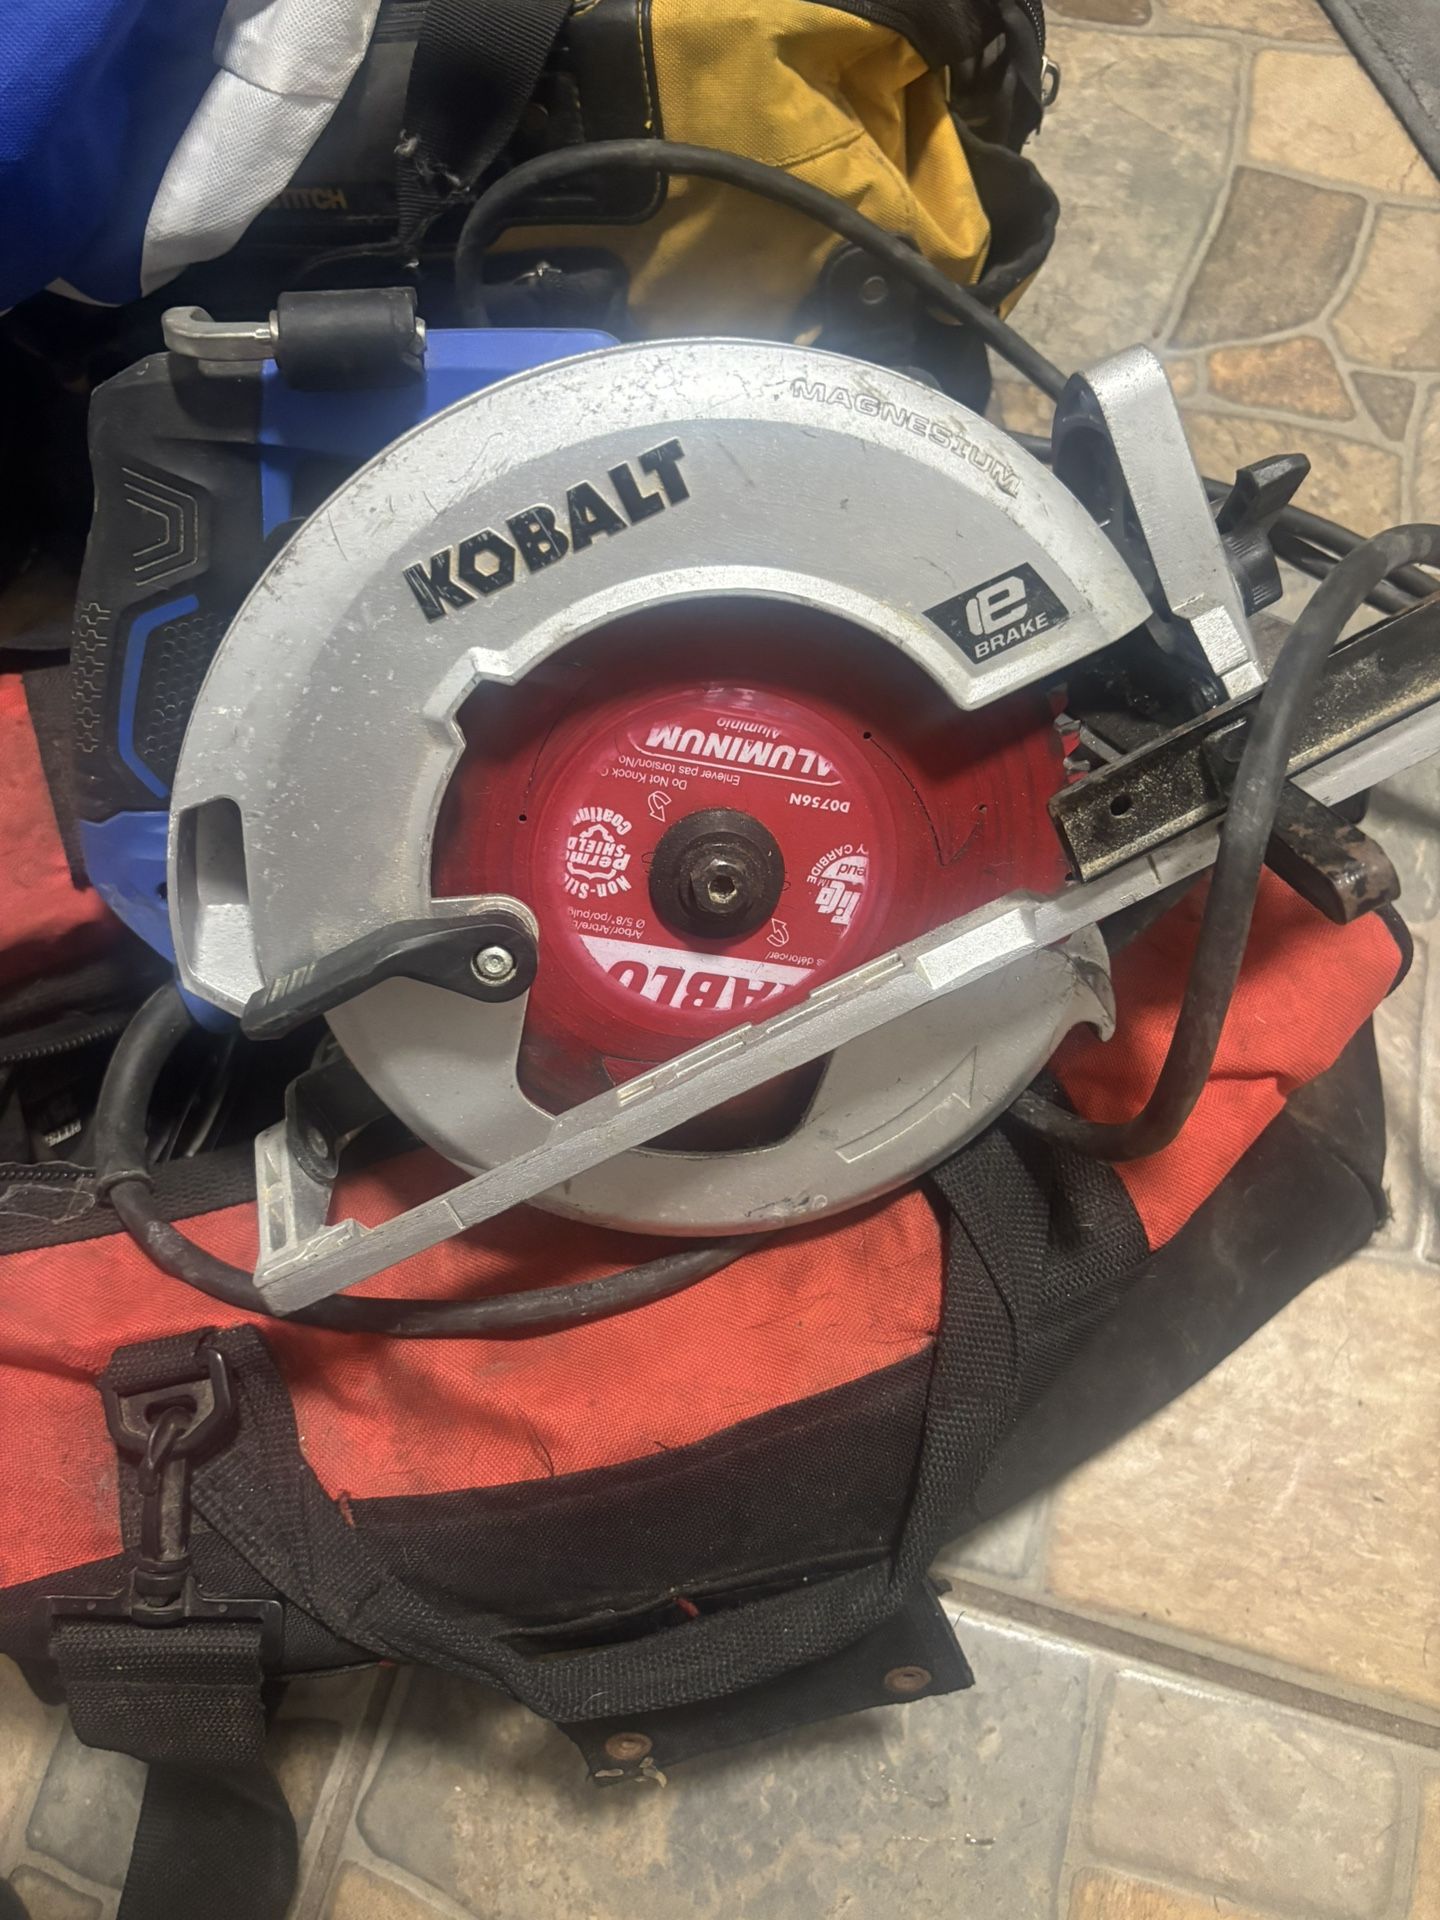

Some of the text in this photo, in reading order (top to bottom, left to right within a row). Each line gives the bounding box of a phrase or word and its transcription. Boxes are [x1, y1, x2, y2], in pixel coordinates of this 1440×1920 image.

[792, 378, 1023, 499] MAGNESIUM
[402, 435, 690, 624] KOBALT
[974, 612, 1049, 659] BRAKE
[645, 723, 833, 777] ALUMINUM
[612, 767, 647, 783] Knock
[649, 775, 669, 787] Not
[678, 765, 699, 777] pas
[700, 768, 740, 786] Enlever
[671, 779, 688, 790] Do
[789, 793, 850, 813] D0756N
[567, 836, 626, 858] SHIELD
[806, 843, 853, 885] CARBIDE
